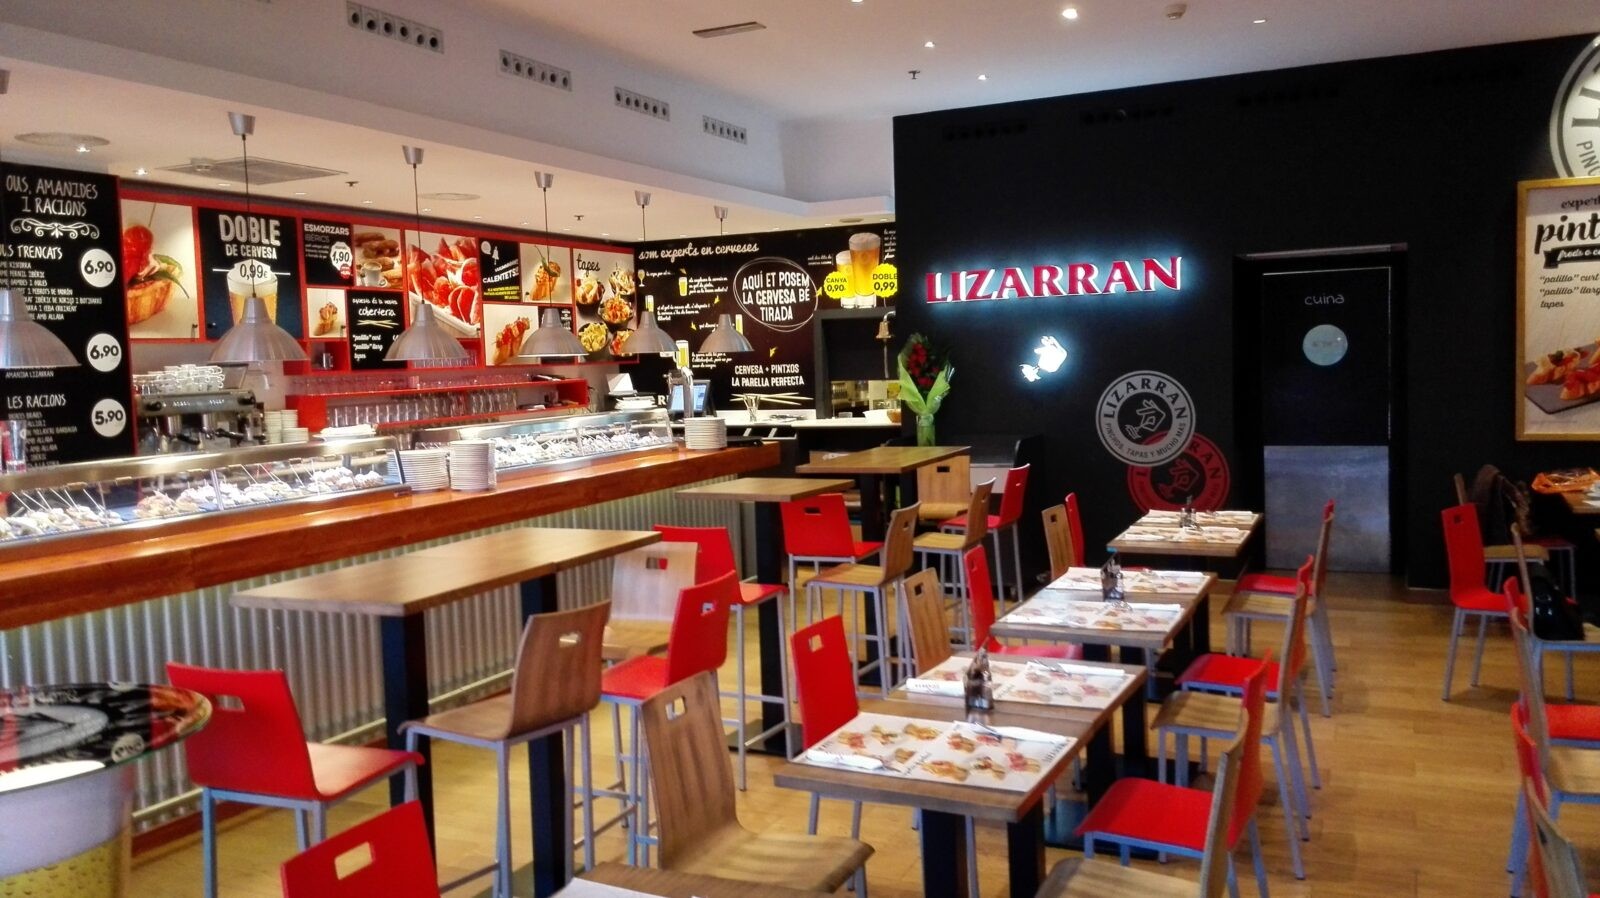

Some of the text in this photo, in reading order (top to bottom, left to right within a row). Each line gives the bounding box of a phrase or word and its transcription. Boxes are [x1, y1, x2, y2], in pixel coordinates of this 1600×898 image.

[36, 178, 98, 200] AMANIDES
[35, 197, 87, 217] RACIONS
[218, 214, 281, 246] DOBLE
[304, 223, 350, 236] ESMORZARS
[18, 245, 63, 260] TRENCATS
[225, 243, 278, 260] DE CERVESA
[638, 242, 759, 263] som experts en cerveses
[84, 260, 114, 275] 6,90
[576, 253, 601, 277] tapes
[742, 271, 763, 291] AQUÍ
[766, 272, 776, 288] ET
[779, 271, 810, 287] POSEM
[925, 256, 1182, 304] LIZARRAN
[742, 291, 754, 305] LA
[755, 288, 797, 305] CERVESA
[1304, 292, 1345, 305] cuina
[760, 305, 794, 322] TIRADA
[90, 345, 119, 360] 6,90
[734, 364, 763, 375] CERVESA
[771, 364, 799, 375] PINTXOS
[731, 376, 805, 387] LA PARELLA PERFECTA
[7, 393, 66, 409] LES RACIONS
[1104, 378, 1187, 420] LIZARRAN
[94, 410, 124, 426] 5,90
